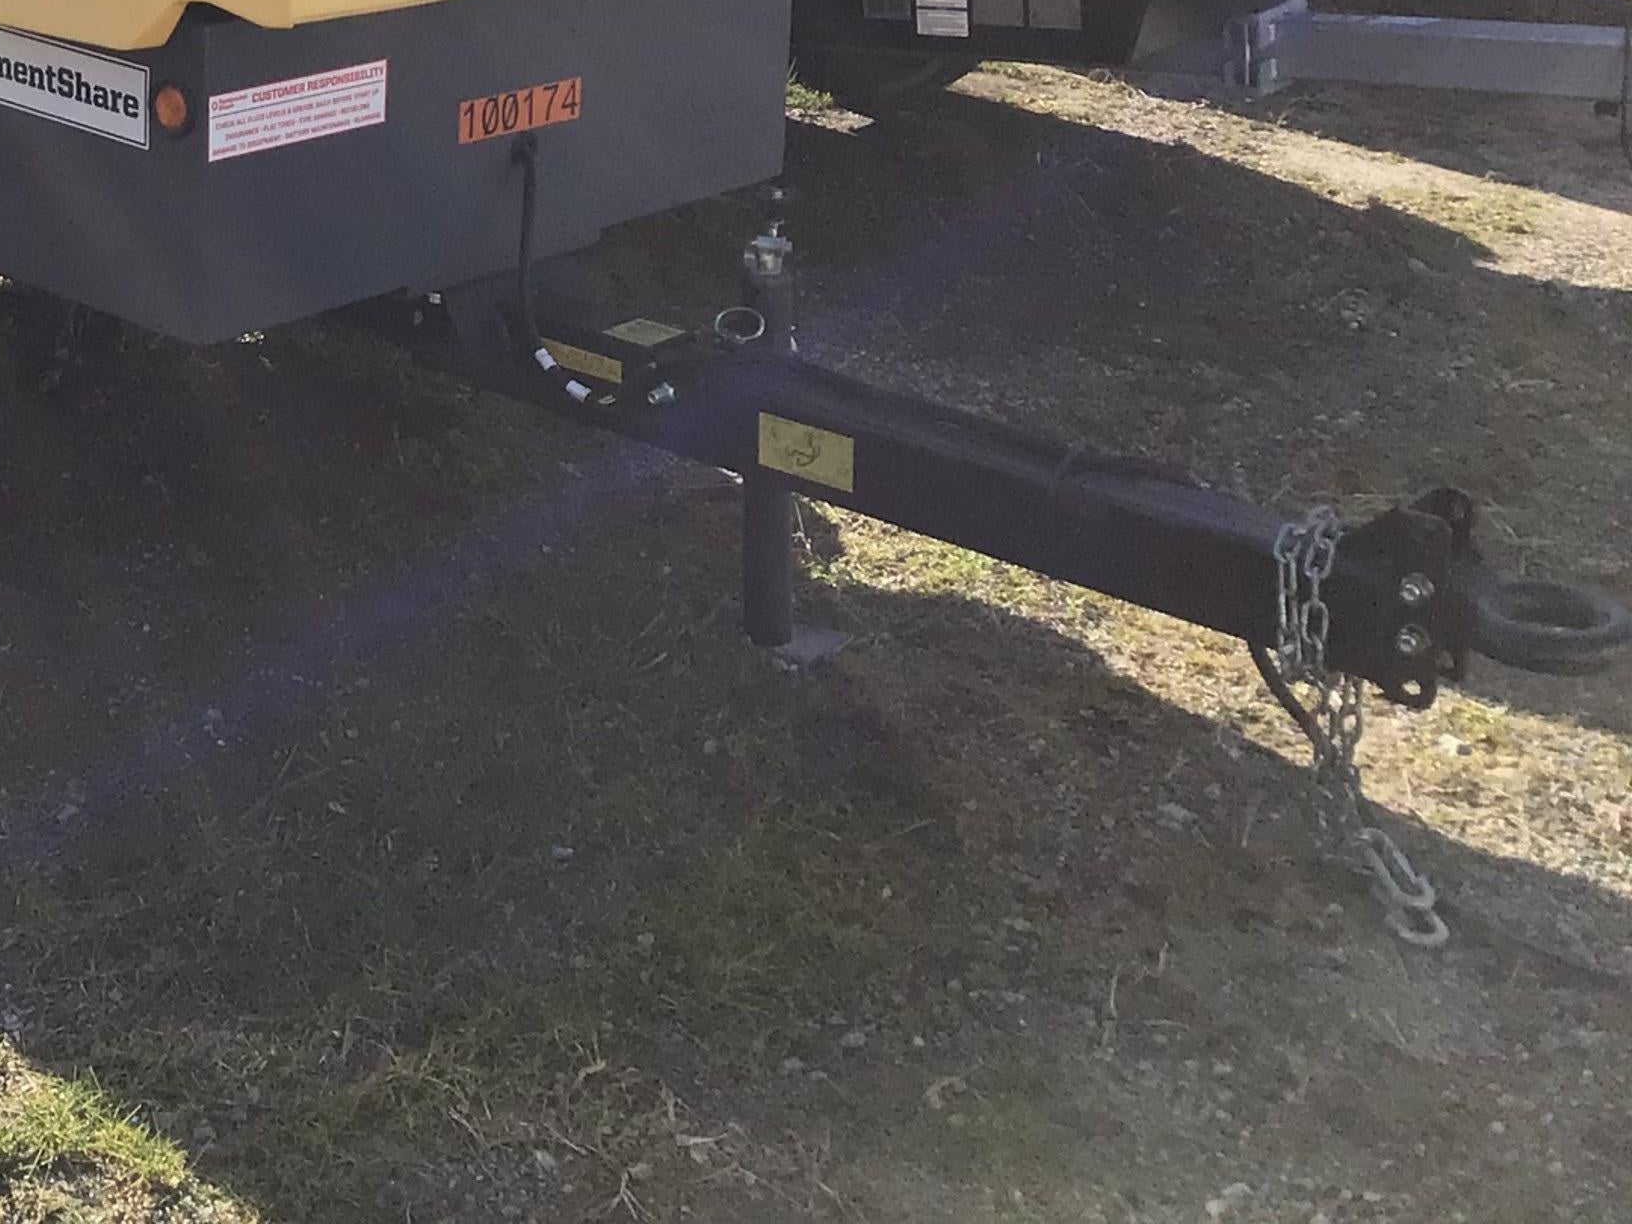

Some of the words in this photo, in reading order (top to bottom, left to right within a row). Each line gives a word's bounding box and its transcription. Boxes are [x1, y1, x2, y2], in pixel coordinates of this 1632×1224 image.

[252, 83, 306, 103] CUSTOMER
[307, 67, 384, 91] RESPONSIBILITY
[464, 80, 578, 138] 100174
